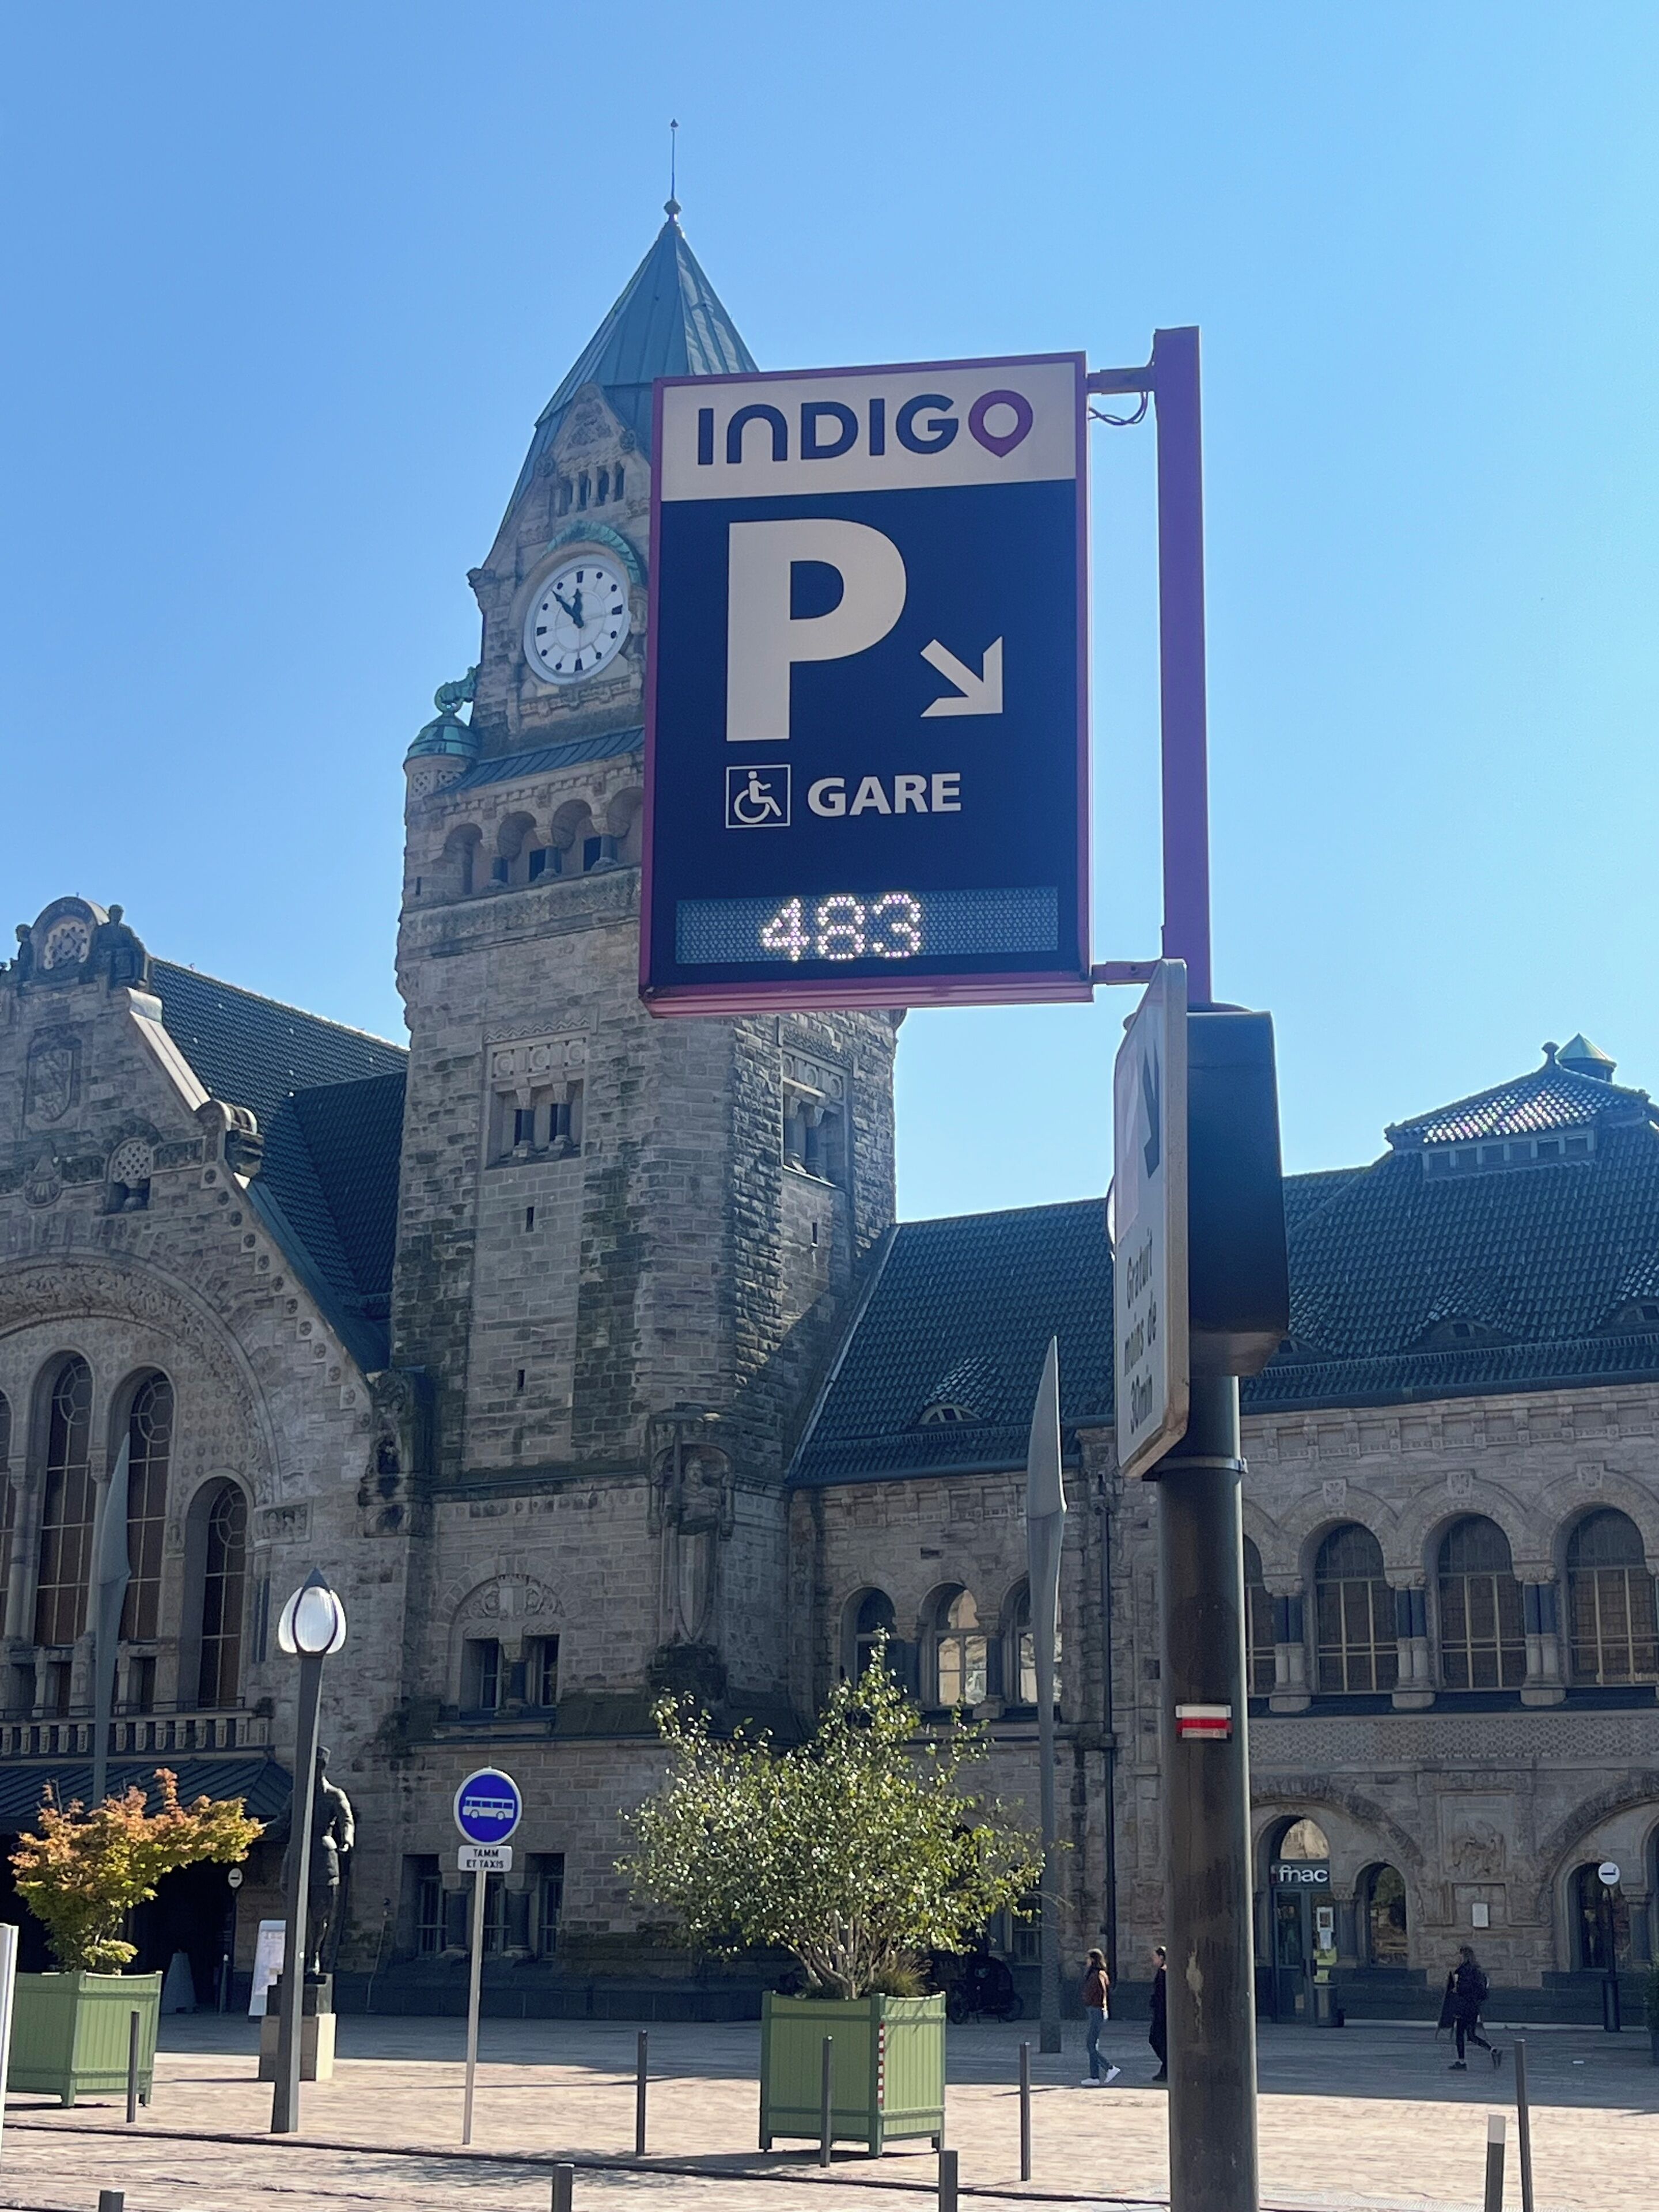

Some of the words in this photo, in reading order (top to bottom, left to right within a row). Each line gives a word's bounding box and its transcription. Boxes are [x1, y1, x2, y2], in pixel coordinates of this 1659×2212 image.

[726, 518, 907, 741] P
[806, 772, 962, 816] GARE
[760, 892, 923, 963] 483
[1147, 1289, 1157, 1347] de
[466, 1859, 477, 1868] ET
[479, 1859, 504, 1869] TAXIS
[1279, 1864, 1328, 1883] fnac
